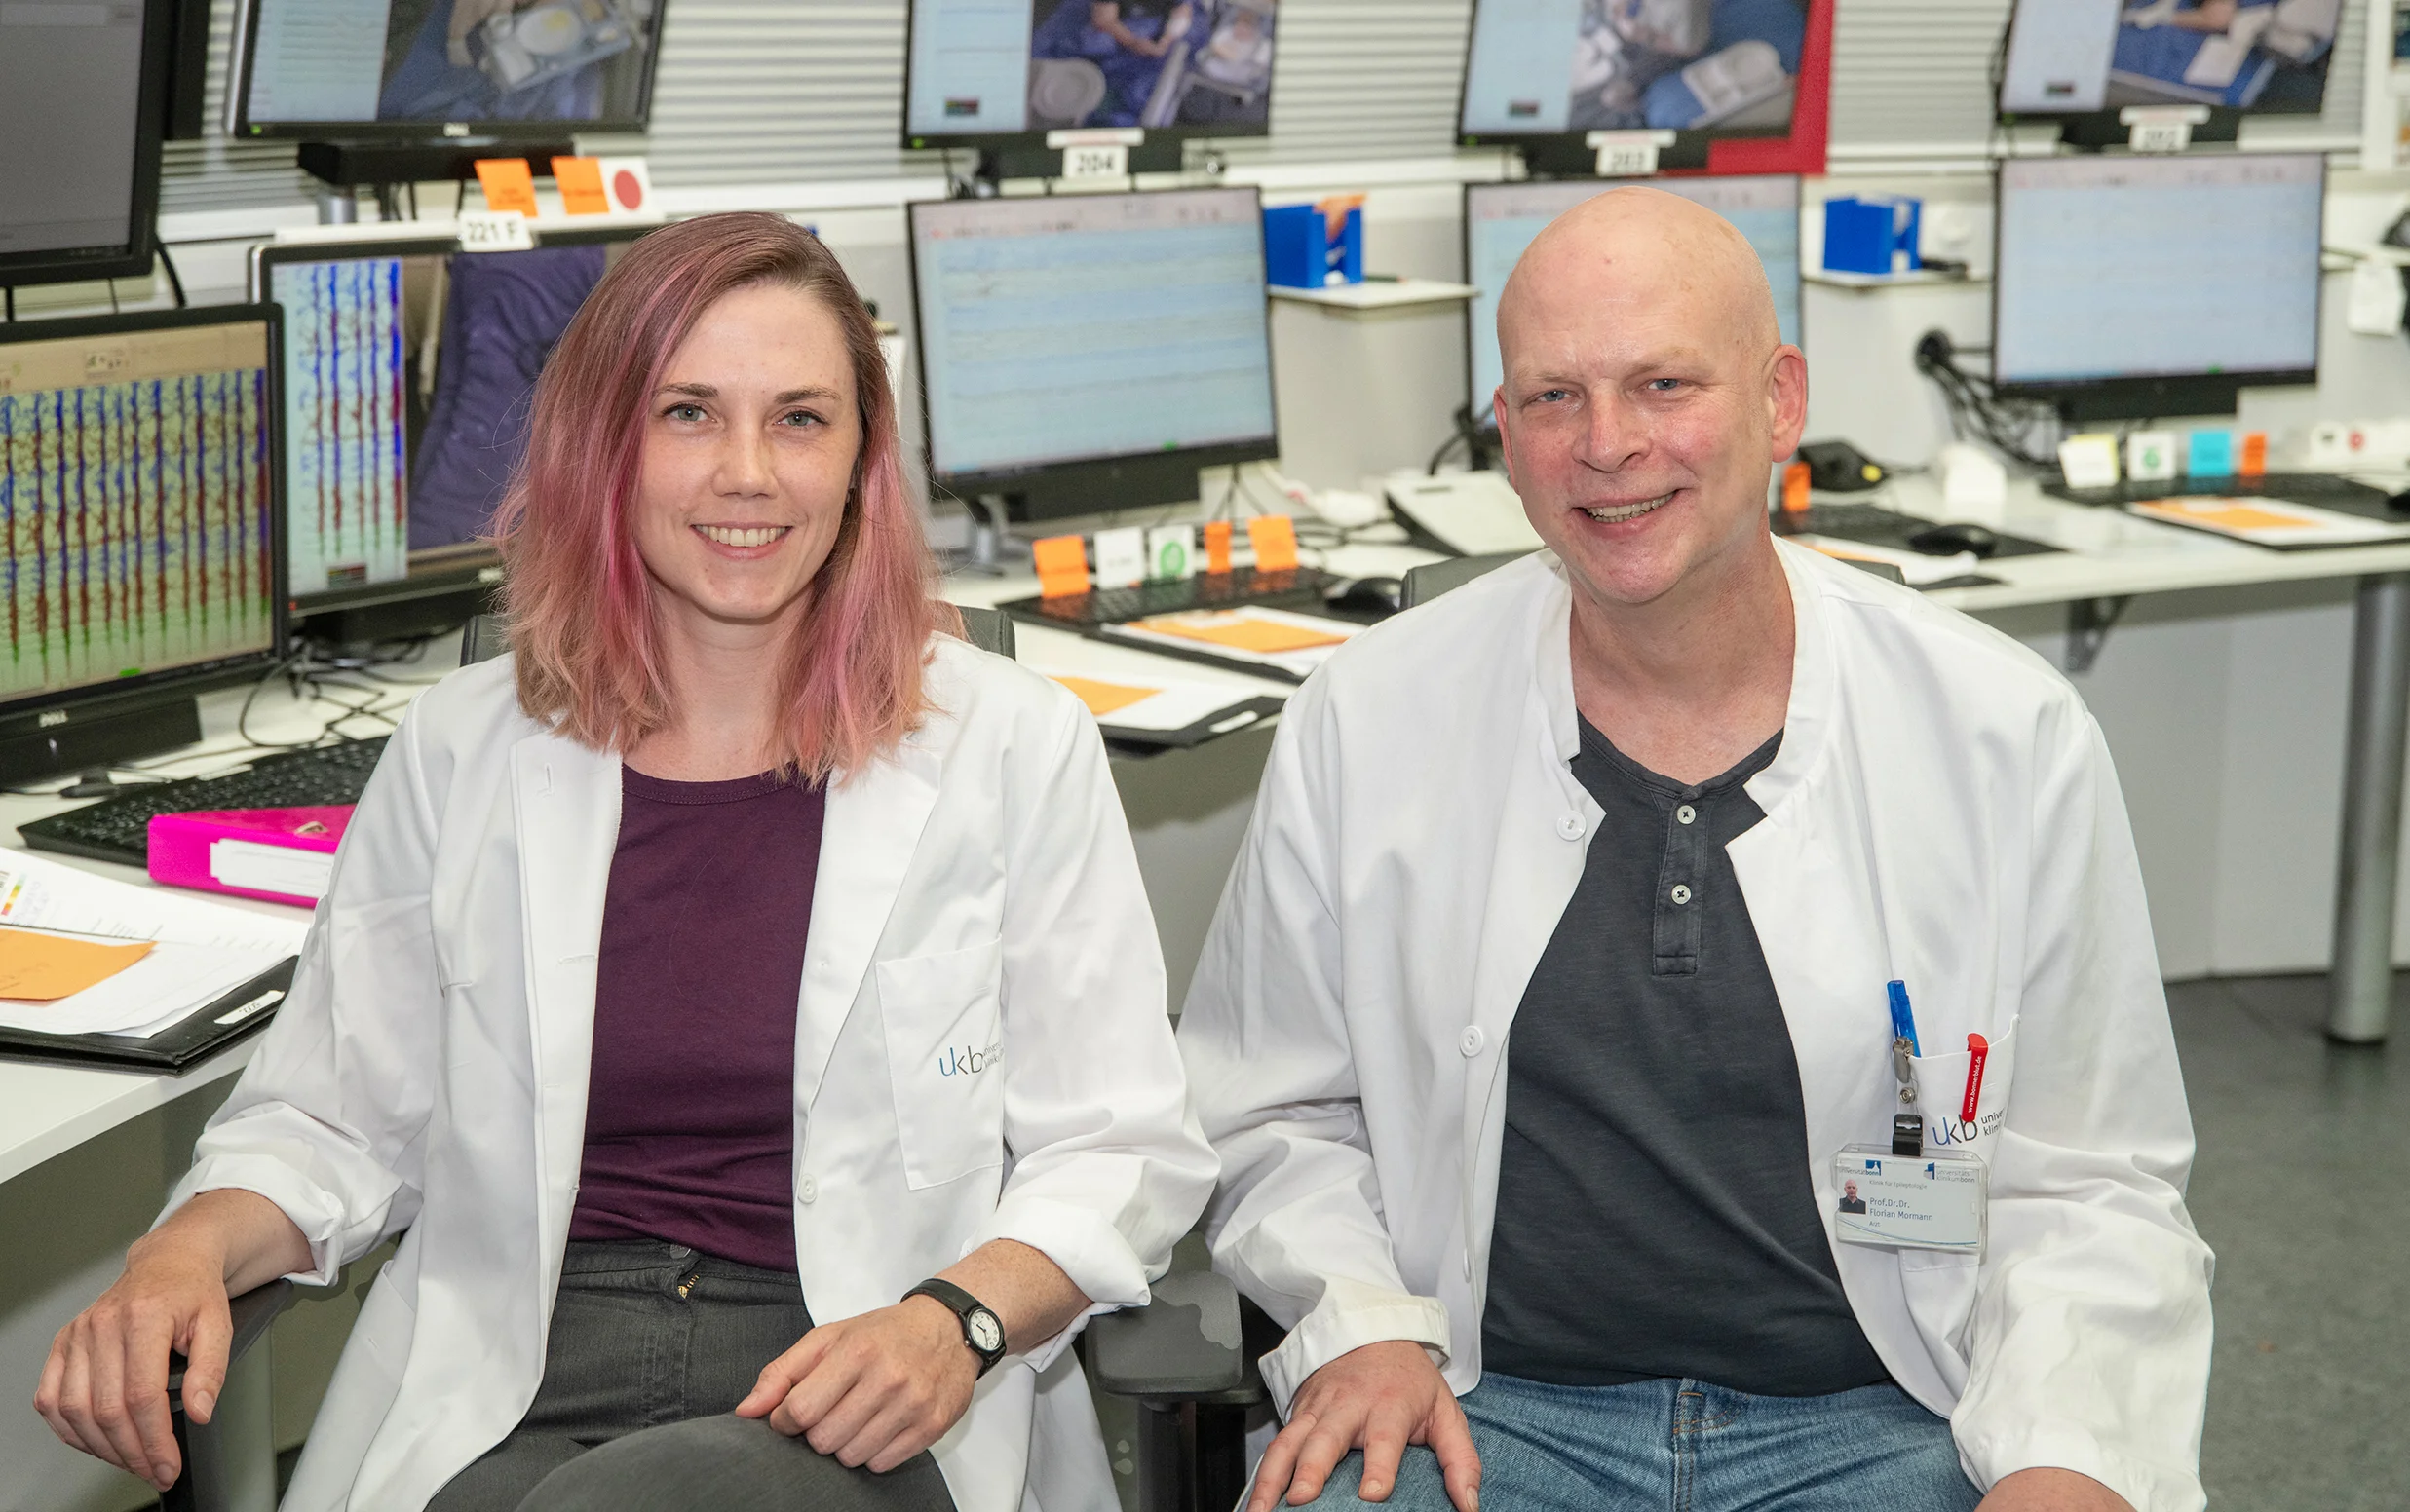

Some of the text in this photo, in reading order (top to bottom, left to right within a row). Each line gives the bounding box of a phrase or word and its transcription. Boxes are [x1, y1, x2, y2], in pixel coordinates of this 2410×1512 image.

[1077, 153, 1113, 171] 204
[467, 221, 518, 243] 221 F
[938, 1045, 983, 1077] ukb
[1969, 1055, 1982, 1113] www.bonnerblut.de
[1932, 1114, 1978, 1146] ukb
[1869, 1197, 1910, 1209] Prof.Dr.Dr.
[1869, 1208, 1933, 1222] Florian Mormann
